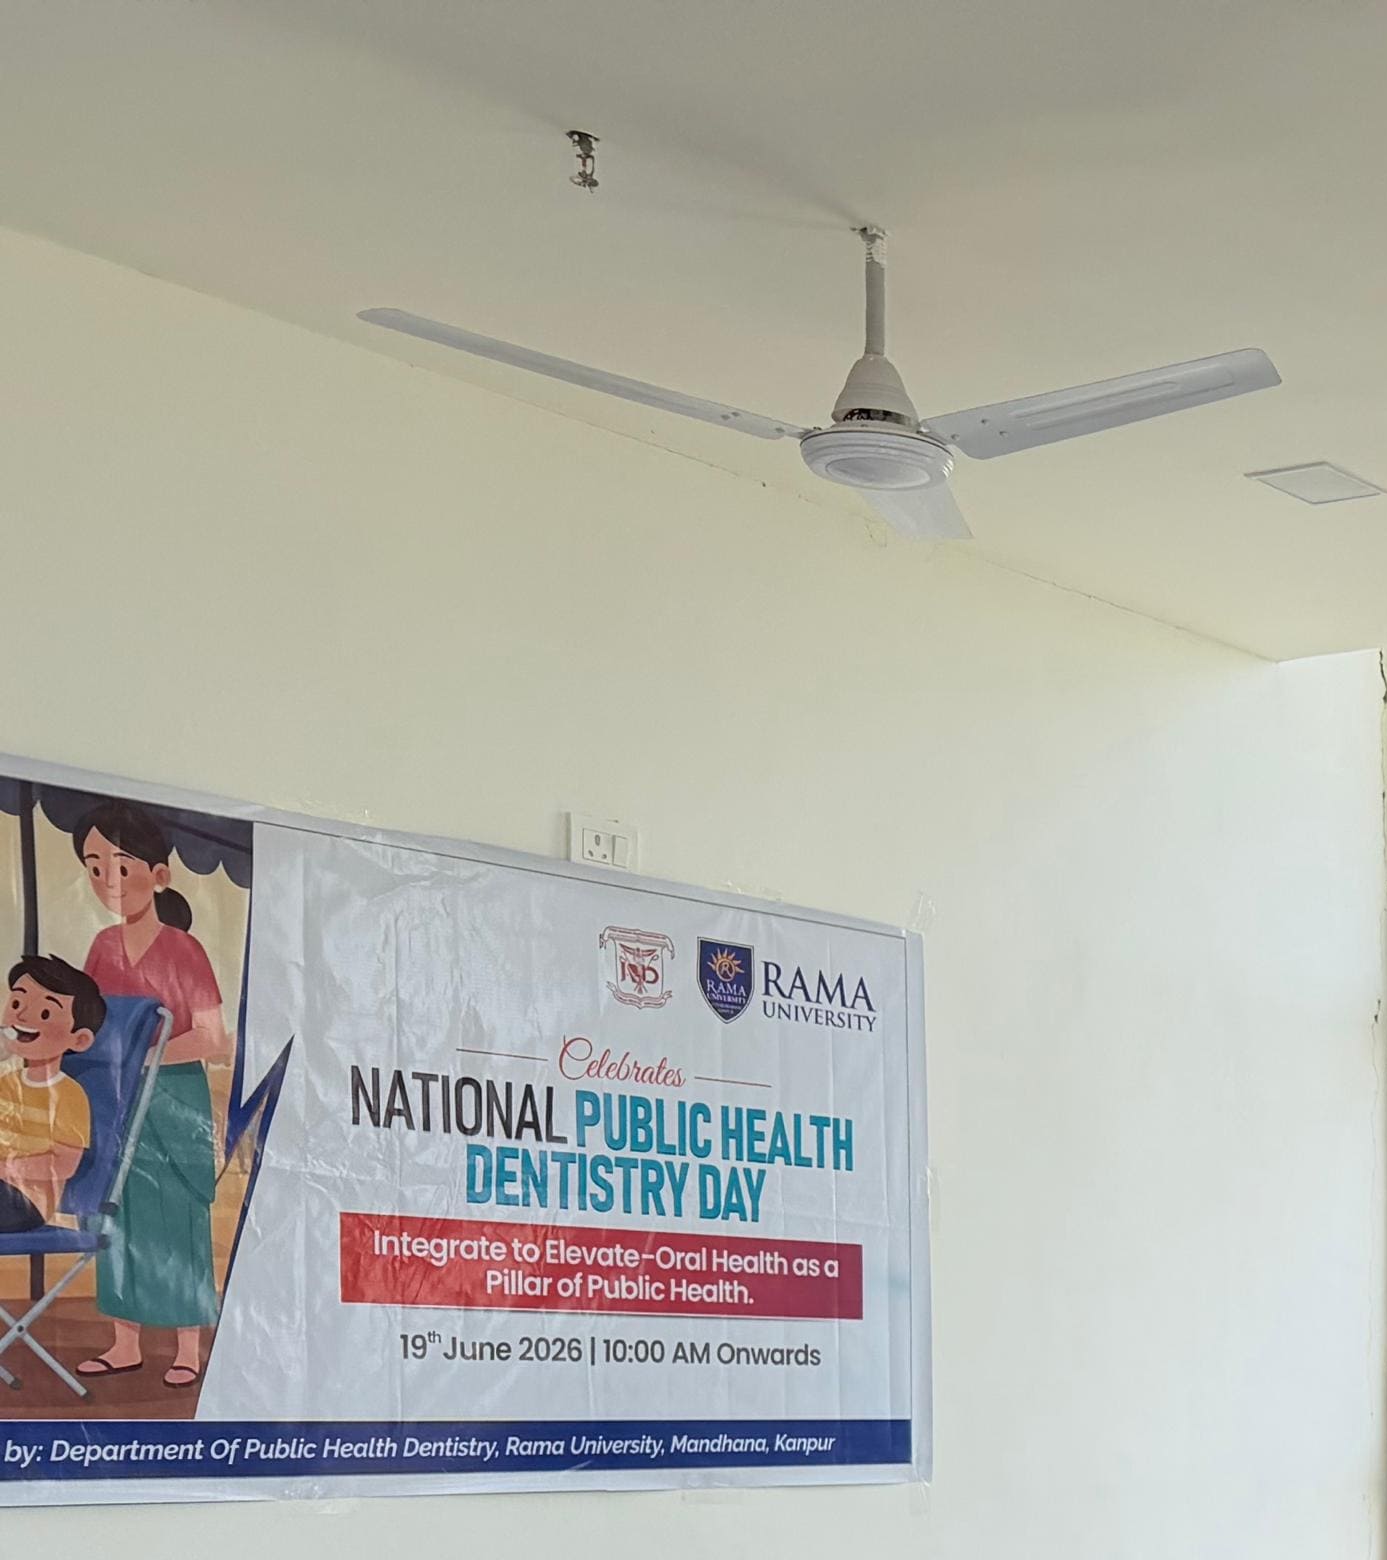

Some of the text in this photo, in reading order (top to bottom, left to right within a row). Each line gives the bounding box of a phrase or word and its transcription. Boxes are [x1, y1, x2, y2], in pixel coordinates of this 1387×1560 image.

[706, 979, 746, 997] RAMA
[761, 960, 877, 1012] RAMA
[762, 1001, 877, 1032] UNIVERSITY
[559, 1035, 686, 1088] Celebrates
[351, 1065, 853, 1172] NATIONAL PUBLIC HEALTH
[466, 1143, 767, 1223] DENTISTRY DAY
[374, 1230, 507, 1267] Integrate
[512, 1238, 540, 1263] to
[712, 1249, 788, 1275] Health
[793, 1258, 820, 1277] as
[824, 1260, 839, 1277] a
[487, 1268, 754, 1304] Pillar of Public Health.
[443, 1336, 511, 1361] June
[518, 1336, 582, 1362] 2026
[603, 1339, 665, 1363] 10:00
[672, 1342, 710, 1364] AM
[717, 1343, 821, 1366] Onwards
[4, 1433, 836, 1468] by: Department Of Public Health Dentistry, Rama University, Mandhana, Kanpur
